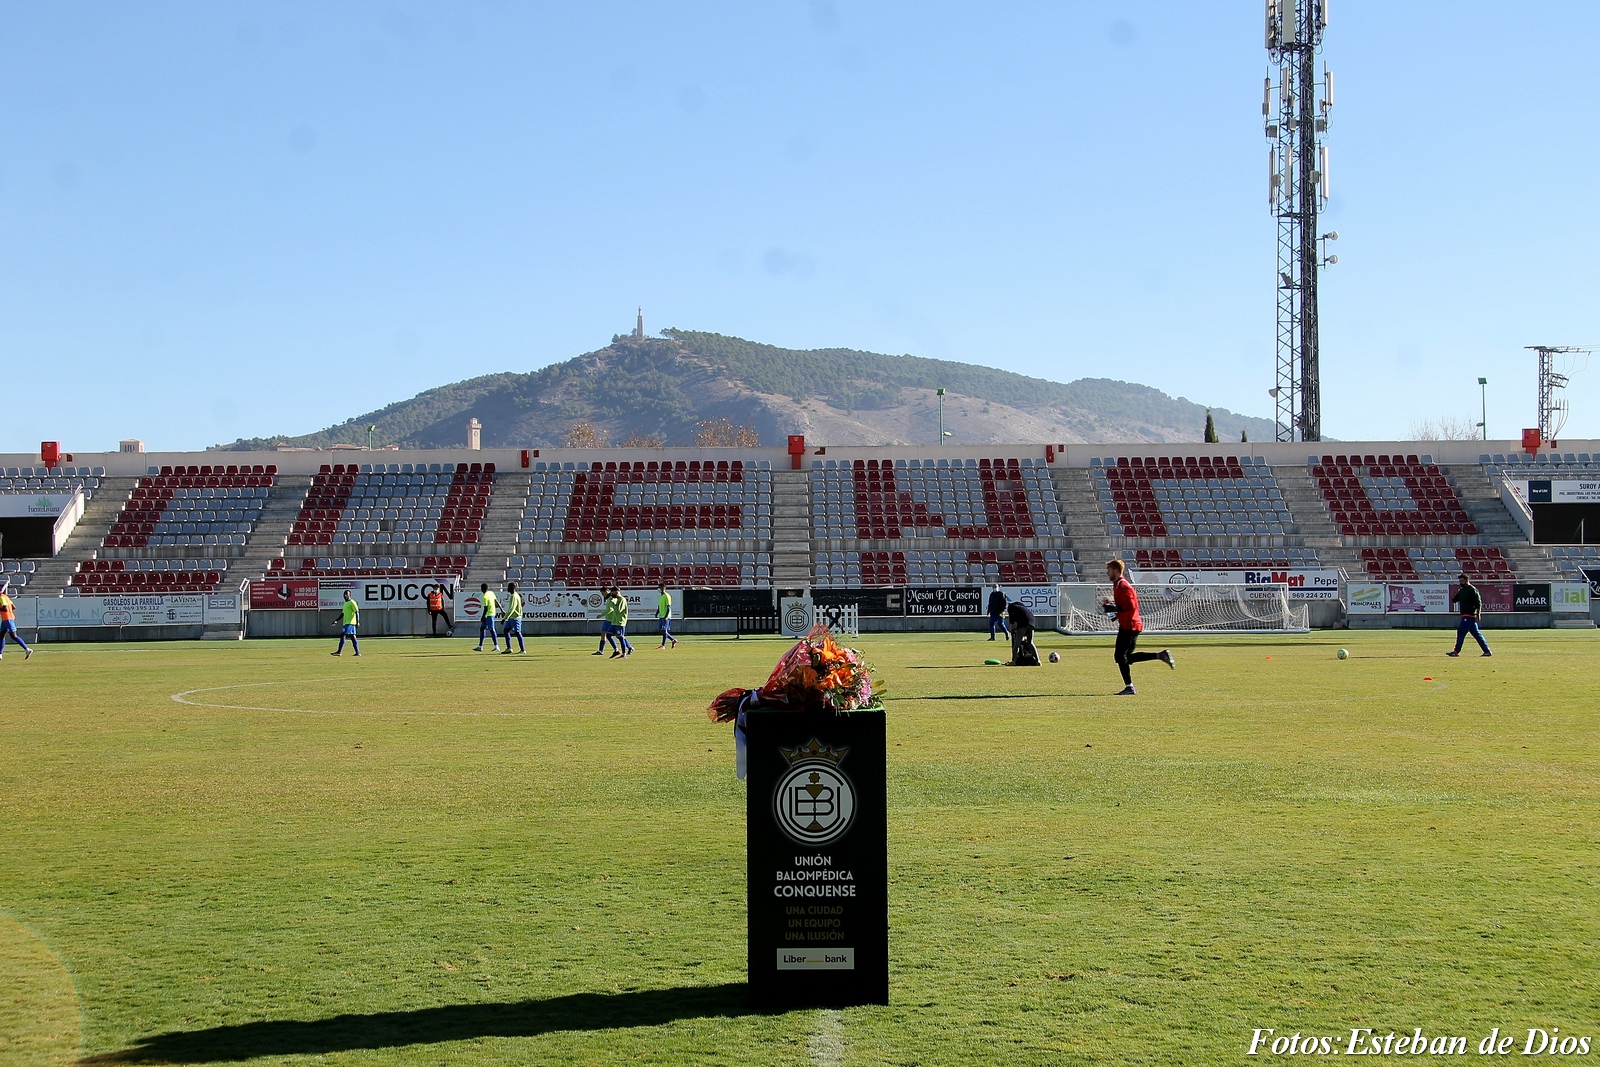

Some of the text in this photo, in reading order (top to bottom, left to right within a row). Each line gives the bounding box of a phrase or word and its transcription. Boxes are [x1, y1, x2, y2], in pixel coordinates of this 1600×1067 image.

[1314, 577, 1338, 587] Pepe
[907, 589, 934, 603] Mesón
[936, 589, 948, 601] El
[1515, 597, 1547, 605] AMBAR
[1553, 588, 1587, 604] dial
[131, 598, 139, 606] LA
[140, 598, 165, 606] PARRILLA
[295, 600, 317, 608] JORGES
[1481, 602, 1511, 610] cuenca
[693, 603, 707, 614] LA
[927, 604, 942, 614] 969
[944, 604, 955, 614] 23
[957, 604, 967, 614] 00
[969, 604, 979, 614] 21
[39, 608, 100, 620] SALOMN
[795, 853, 832, 867] UNIÓN
[776, 868, 854, 881] BALOMPÉDICA
[773, 885, 857, 898] CONQUENSE
[785, 906, 843, 915] UNA CIUDAD
[788, 919, 841, 928] UN EQUIPO
[785, 929, 845, 941] UNA ILUSIÓN
